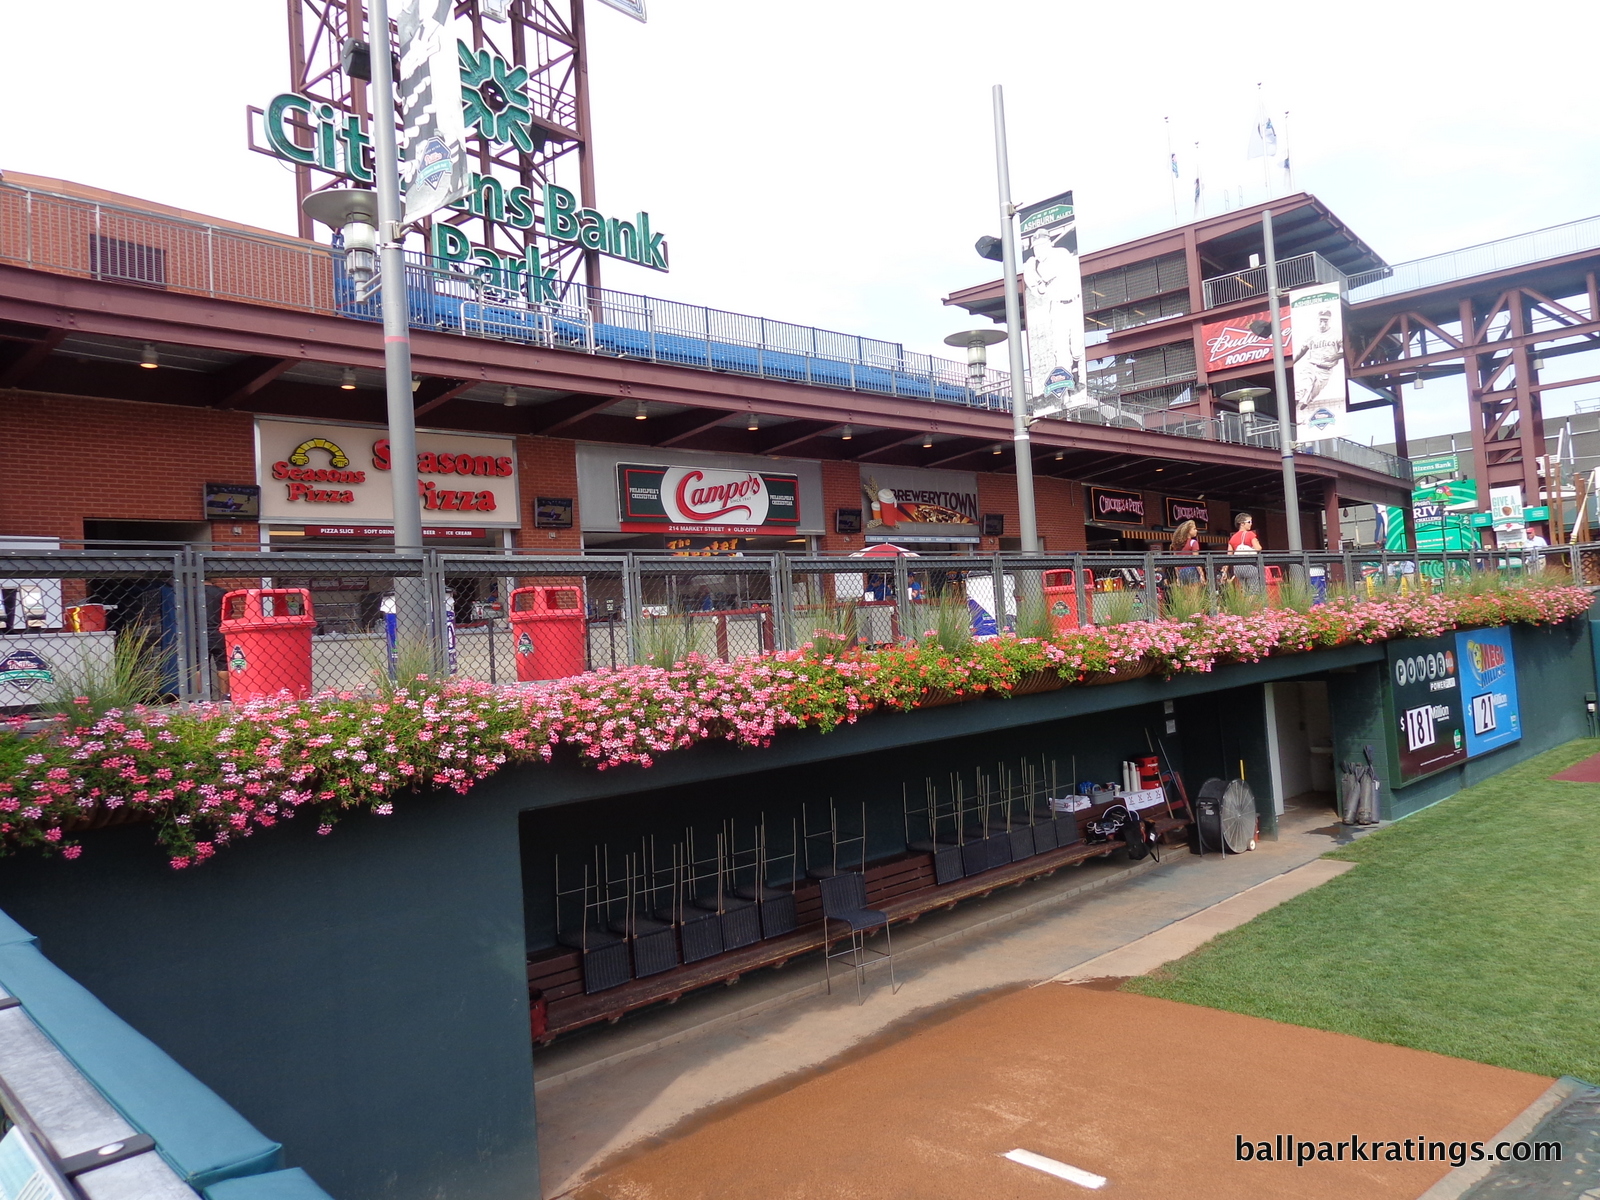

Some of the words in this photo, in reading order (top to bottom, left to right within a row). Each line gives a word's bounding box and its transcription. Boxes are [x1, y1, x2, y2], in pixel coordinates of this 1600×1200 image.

[263, 92, 535, 229] Citns
[543, 182, 670, 272] Bank
[1024, 214, 1055, 232] ASHBURN
[1056, 210, 1072, 220] ALLEY
[431, 221, 562, 308] Park
[1225, 347, 1270, 366] ROOFTOP
[272, 461, 366, 484] Seasons
[372, 438, 513, 477] Sasons
[287, 482, 355, 503] Pizza
[675, 470, 761, 521] Campo's
[890, 488, 978, 520] BREWERYTOWN
[1492, 496, 1509, 507] GIVE
[1510, 495, 1516, 505] A
[667, 538, 691, 550] The
[1481, 643, 1506, 673] MEGA
[1400, 716, 1405, 732] $
[1409, 708, 1432, 748] 181
[1431, 704, 1450, 719] Million
[1481, 696, 1494, 729] 21
